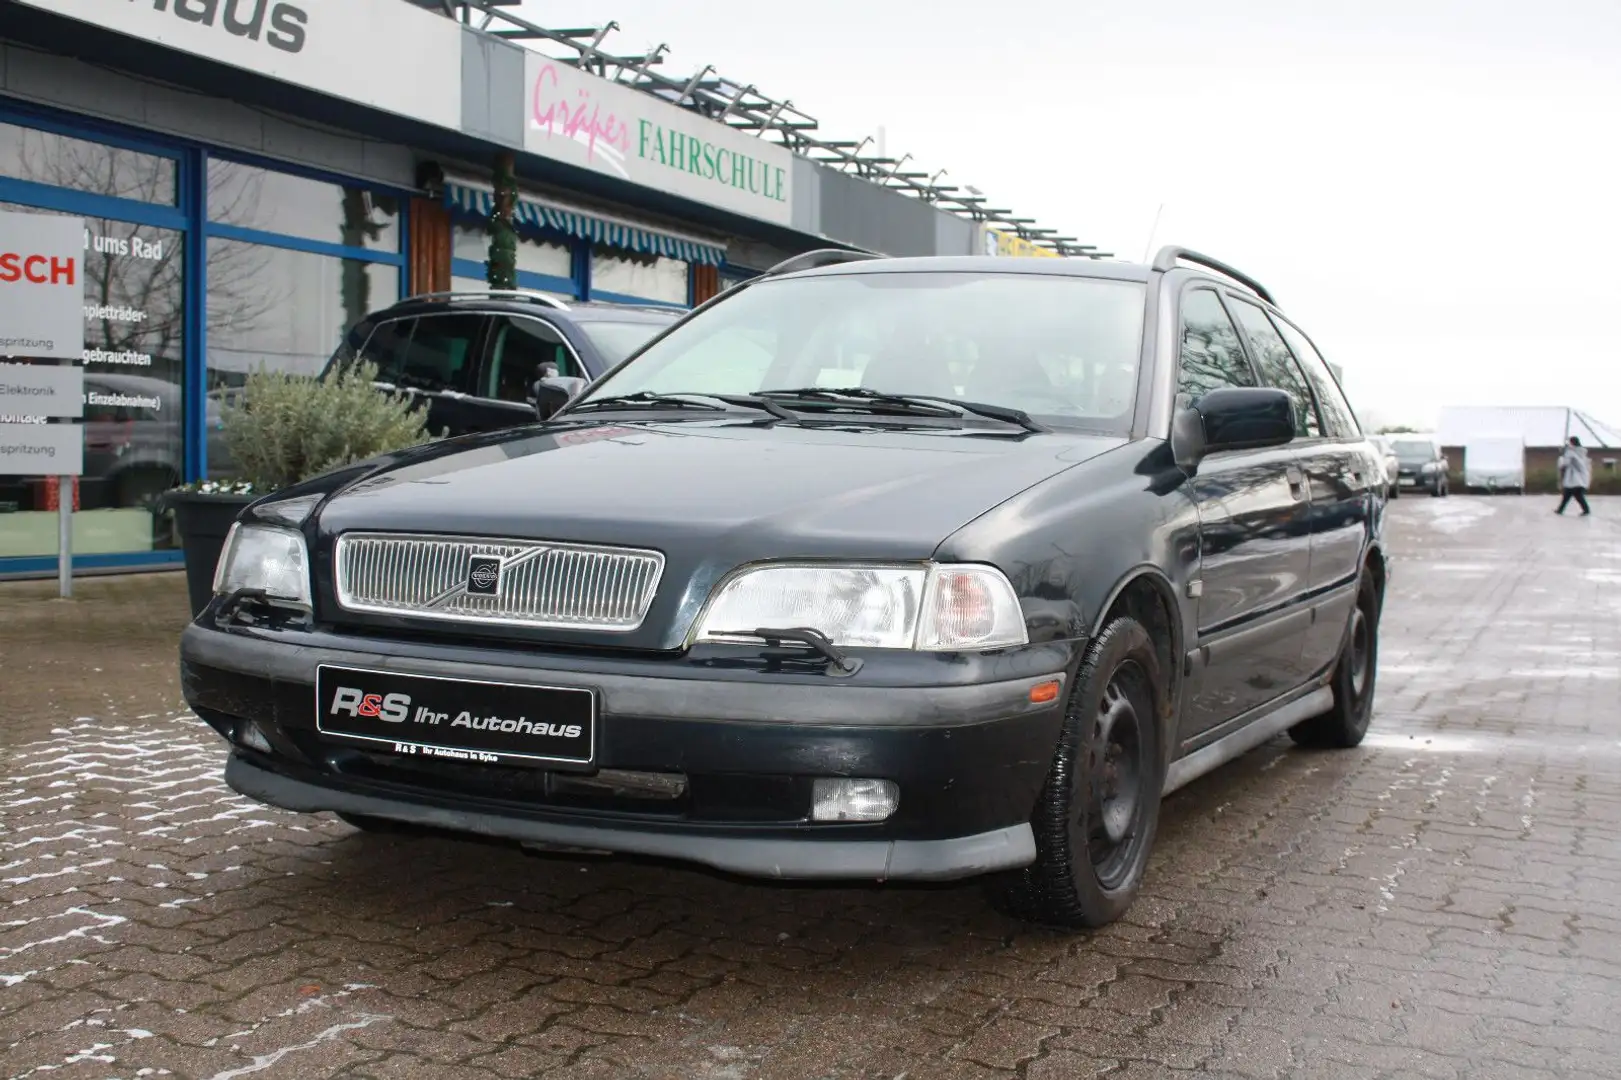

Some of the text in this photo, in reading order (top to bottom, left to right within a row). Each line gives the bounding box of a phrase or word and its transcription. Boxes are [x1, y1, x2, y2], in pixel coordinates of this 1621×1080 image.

[533, 64, 786, 202] Gräper FAHRSCHULE
[94, 235, 128, 256] ums
[131, 236, 162, 260] Rad
[83, 347, 151, 366] gebrauchten
[88, 391, 160, 411] Einzelabnahme)
[330, 686, 582, 738] R&S Ihr Autohaus
[434, 748, 469, 759] Autohaus
[479, 753, 499, 762] Syke
